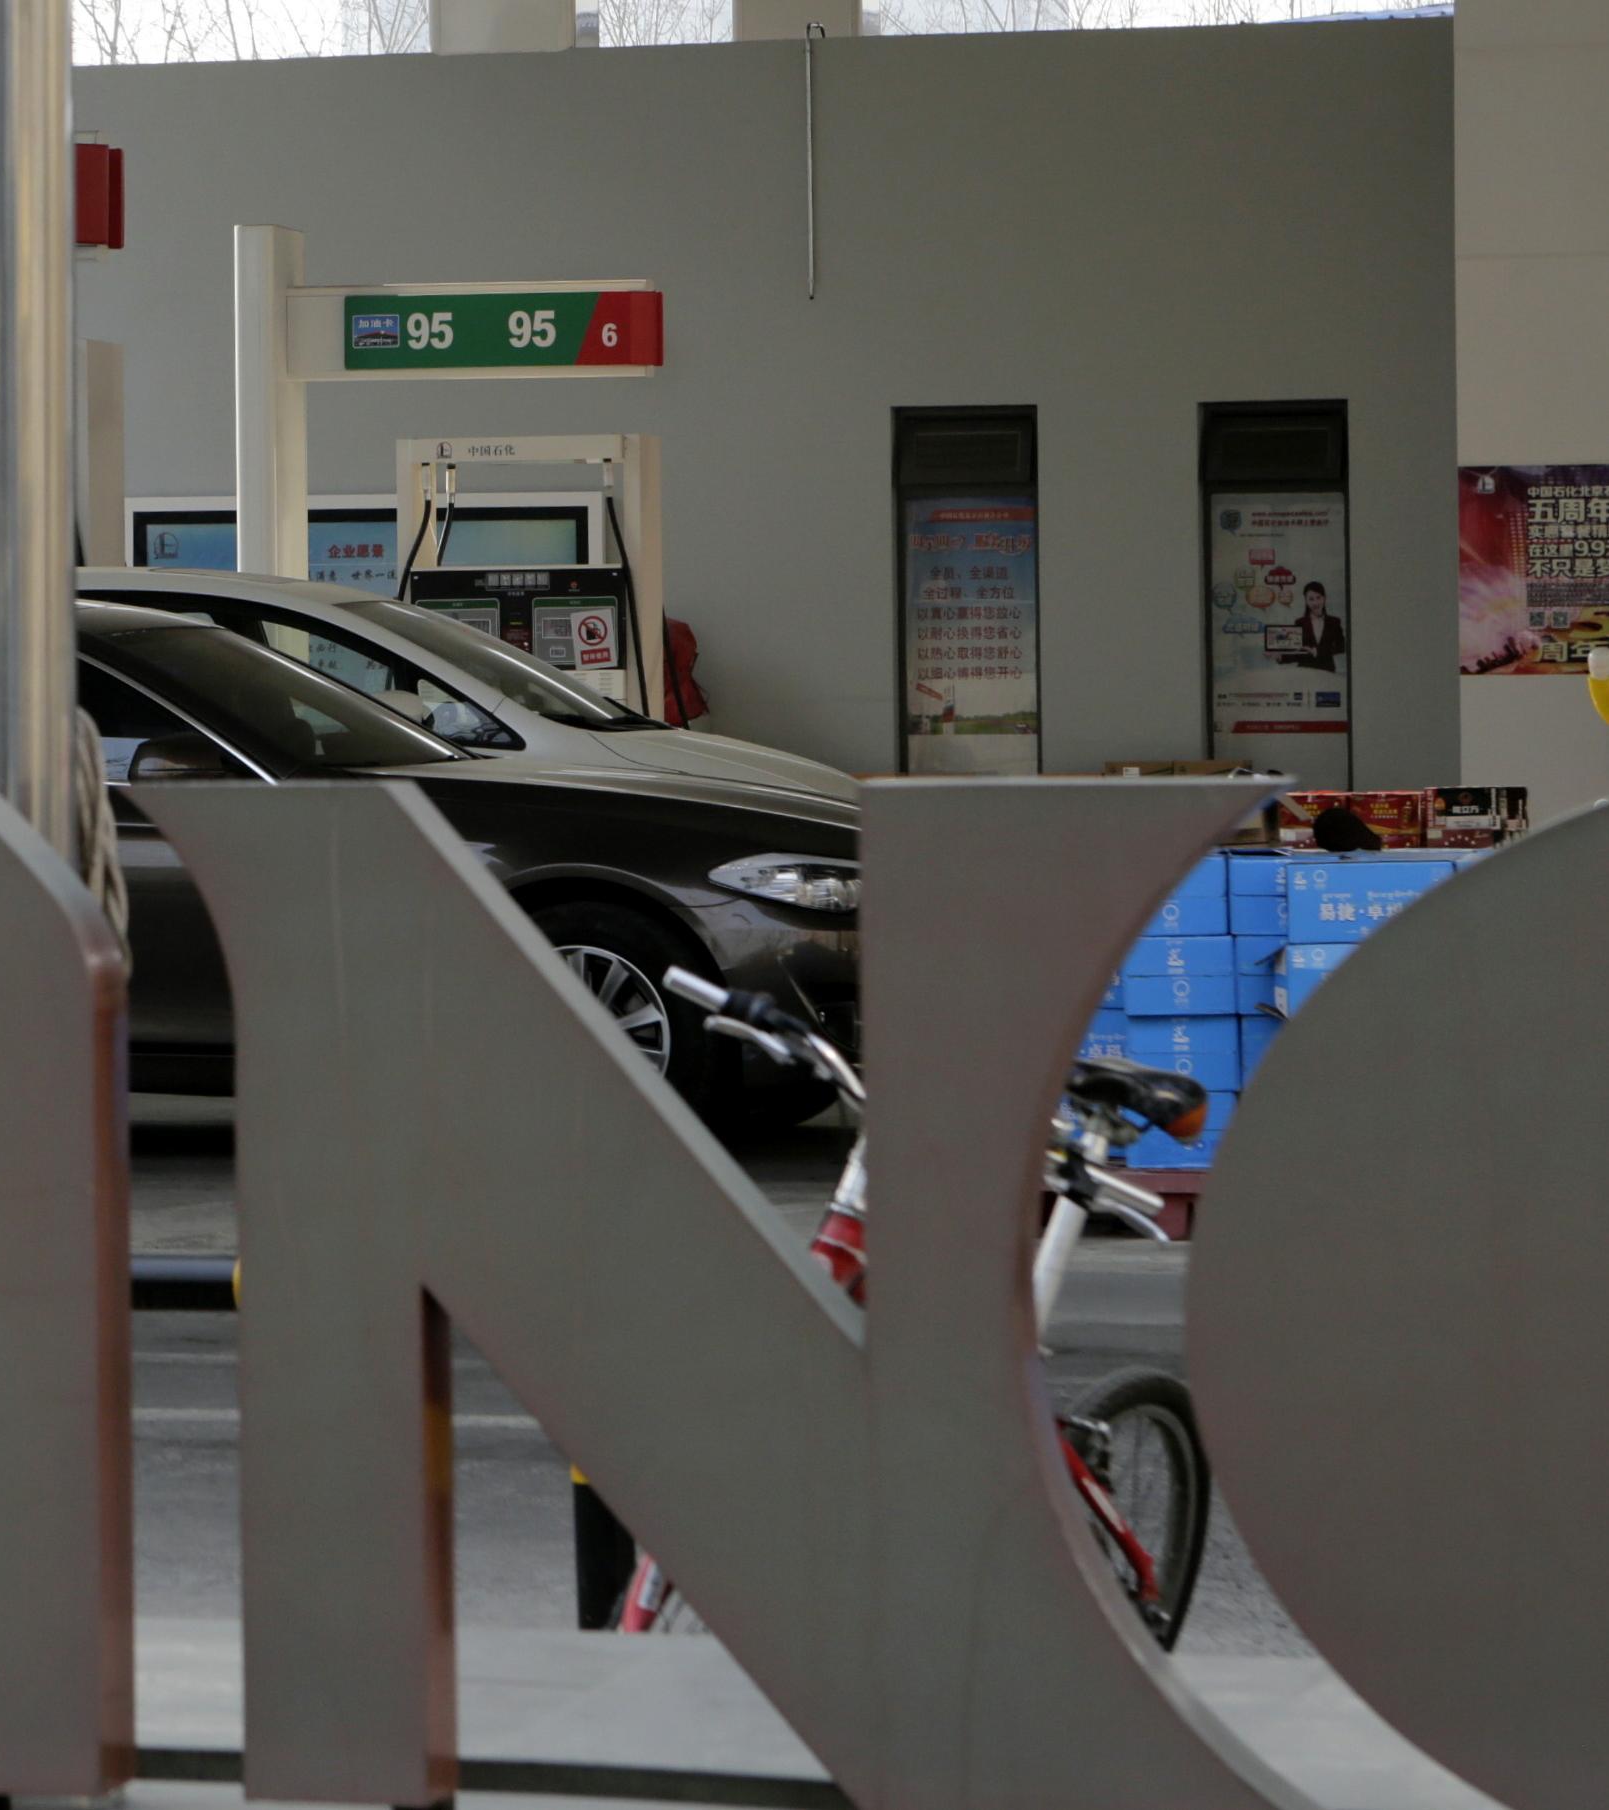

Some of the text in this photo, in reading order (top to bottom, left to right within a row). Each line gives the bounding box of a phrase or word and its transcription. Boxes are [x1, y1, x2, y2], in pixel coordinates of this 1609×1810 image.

[357, 318, 394, 328] 加油卡
[406, 310, 618, 350] 95 95 6
[467, 444, 517, 457] 中国石化
[327, 544, 384, 558] 企业愿景
